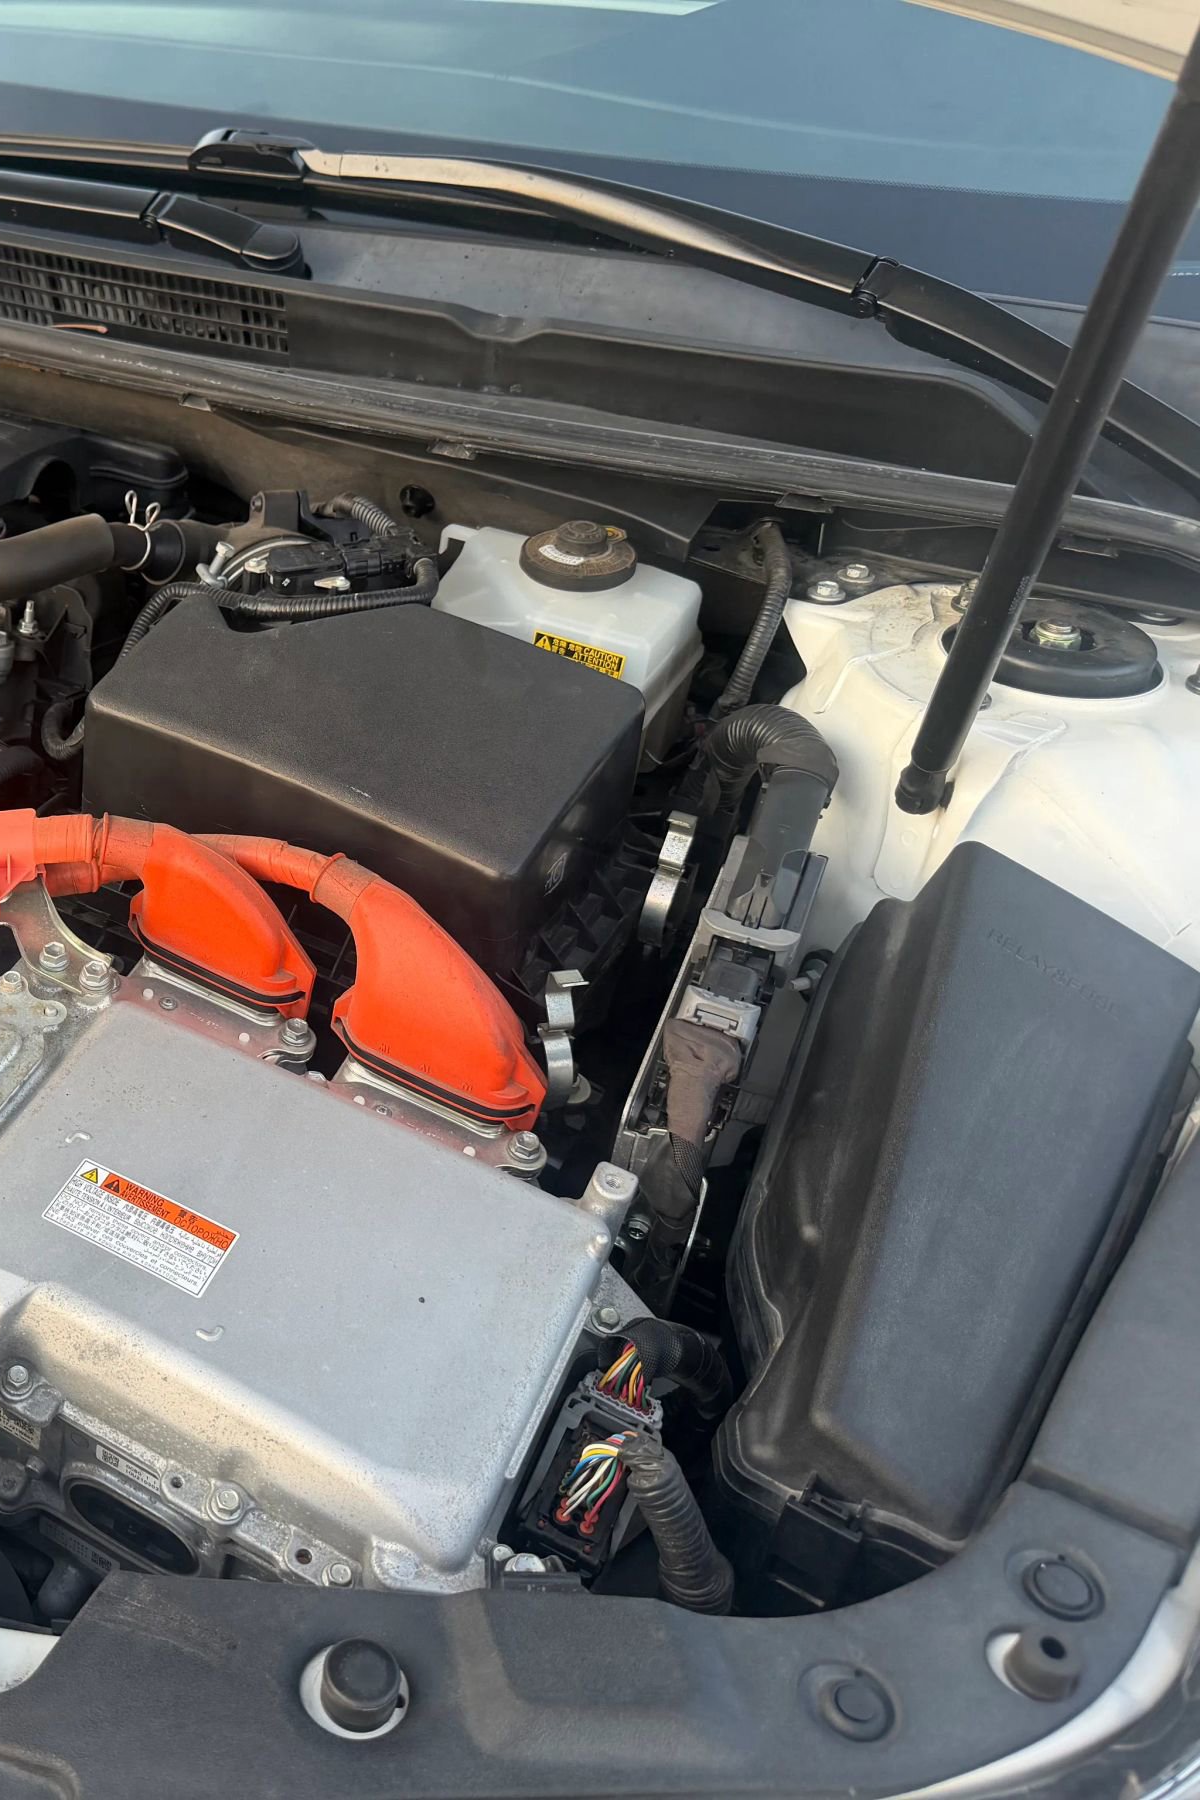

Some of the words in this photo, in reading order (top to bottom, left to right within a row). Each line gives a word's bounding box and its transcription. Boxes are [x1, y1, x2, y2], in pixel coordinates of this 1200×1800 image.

[572, 652, 619, 671] ATTENTION
[583, 647, 620, 664] CAUTION
[64, 1185, 82, 1197] HAUTE
[80, 1192, 101, 1206] TENSION
[69, 1177, 84, 1188] HIGH
[82, 1184, 105, 1199] VOLTAGE
[103, 1194, 121, 1207] INSIDE
[119, 1190, 170, 1219] AVERTISSEMENT
[123, 1183, 165, 1208] WARNING
[61, 1213, 76, 1223] PAS
[77, 1221, 100, 1235] enlever
[101, 1233, 114, 1242] ces
[114, 1240, 148, 1260] couvercles
[72, 1199, 87, 1209] NOT
[87, 1207, 111, 1221] remove
[111, 1219, 129, 1230] these
[130, 1228, 151, 1241] covers
[151, 1239, 172, 1252] and/or
[172, 1216, 230, 1250] ОСТОРОЖНО
